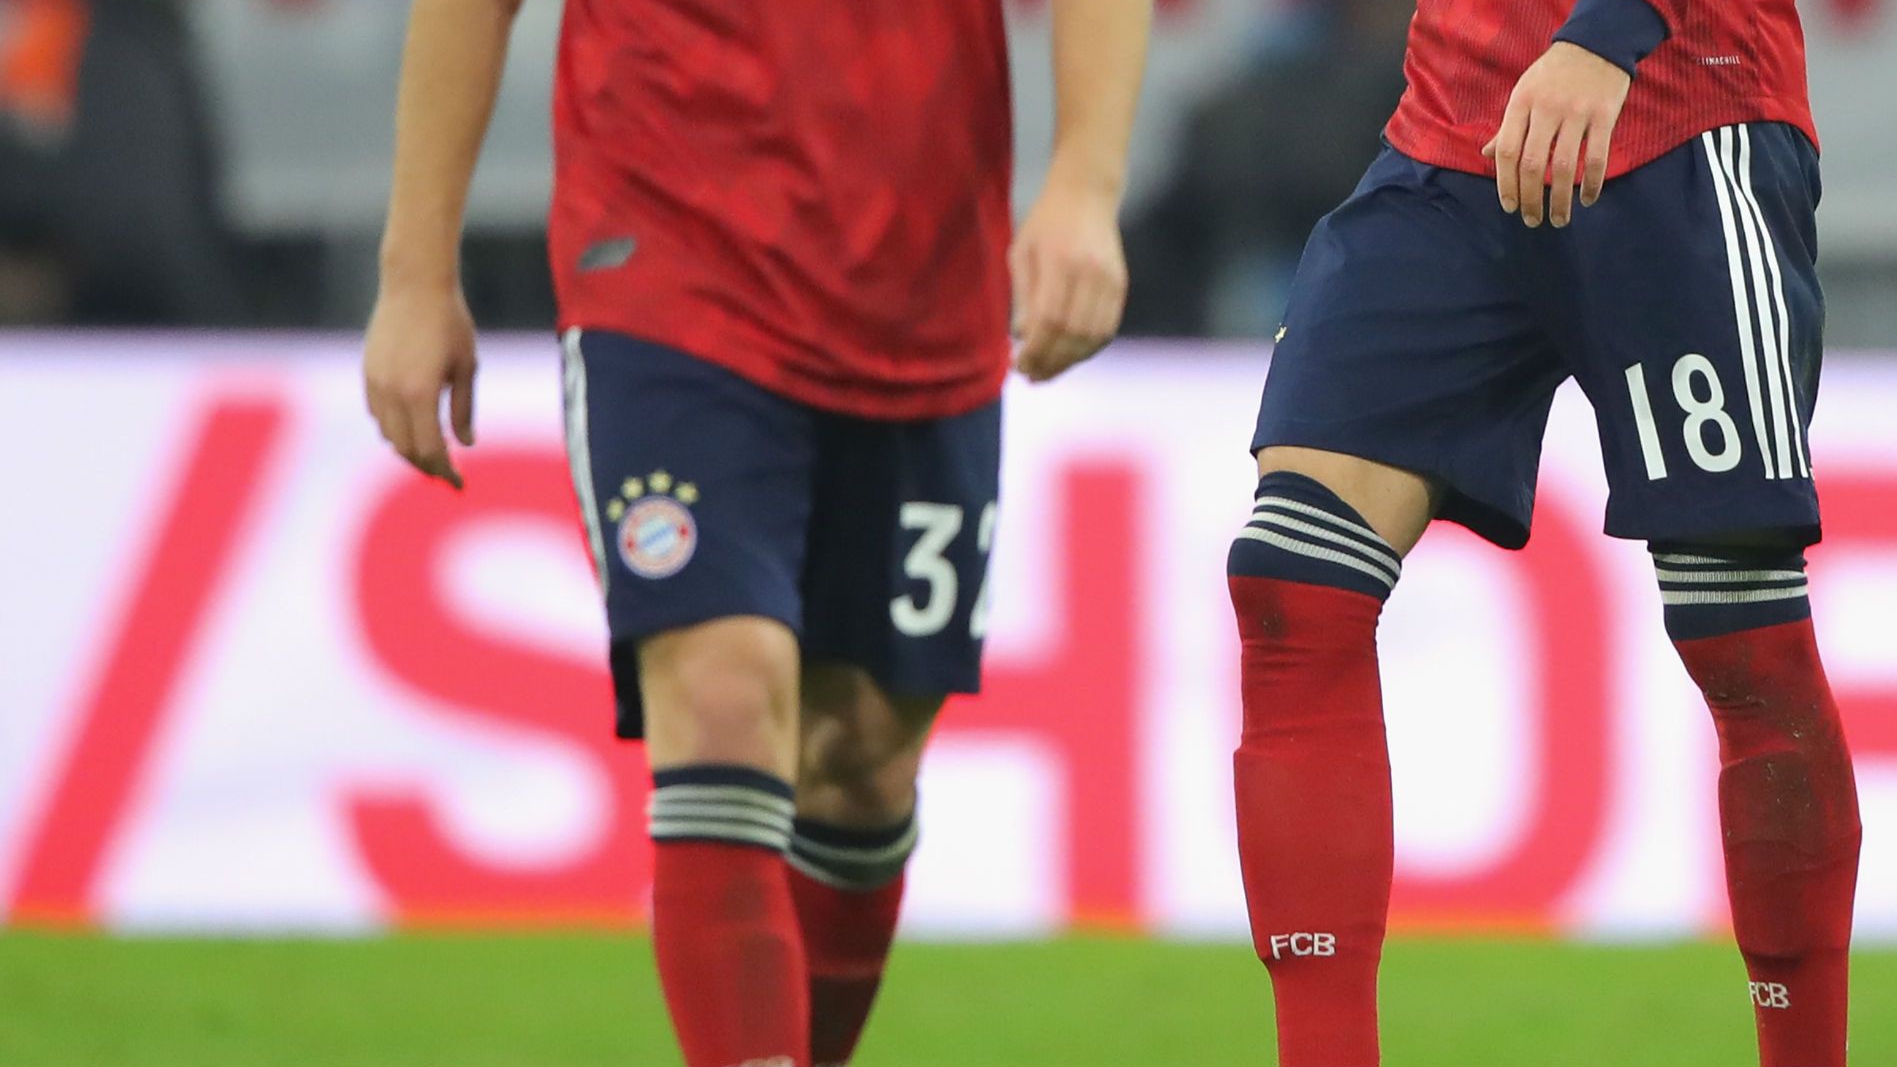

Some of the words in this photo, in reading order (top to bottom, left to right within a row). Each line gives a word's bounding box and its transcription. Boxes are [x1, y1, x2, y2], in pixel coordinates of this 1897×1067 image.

[1623, 352, 1743, 482] 18
[1269, 931, 1336, 961] FCB
[1748, 980, 1791, 1010] FCB
